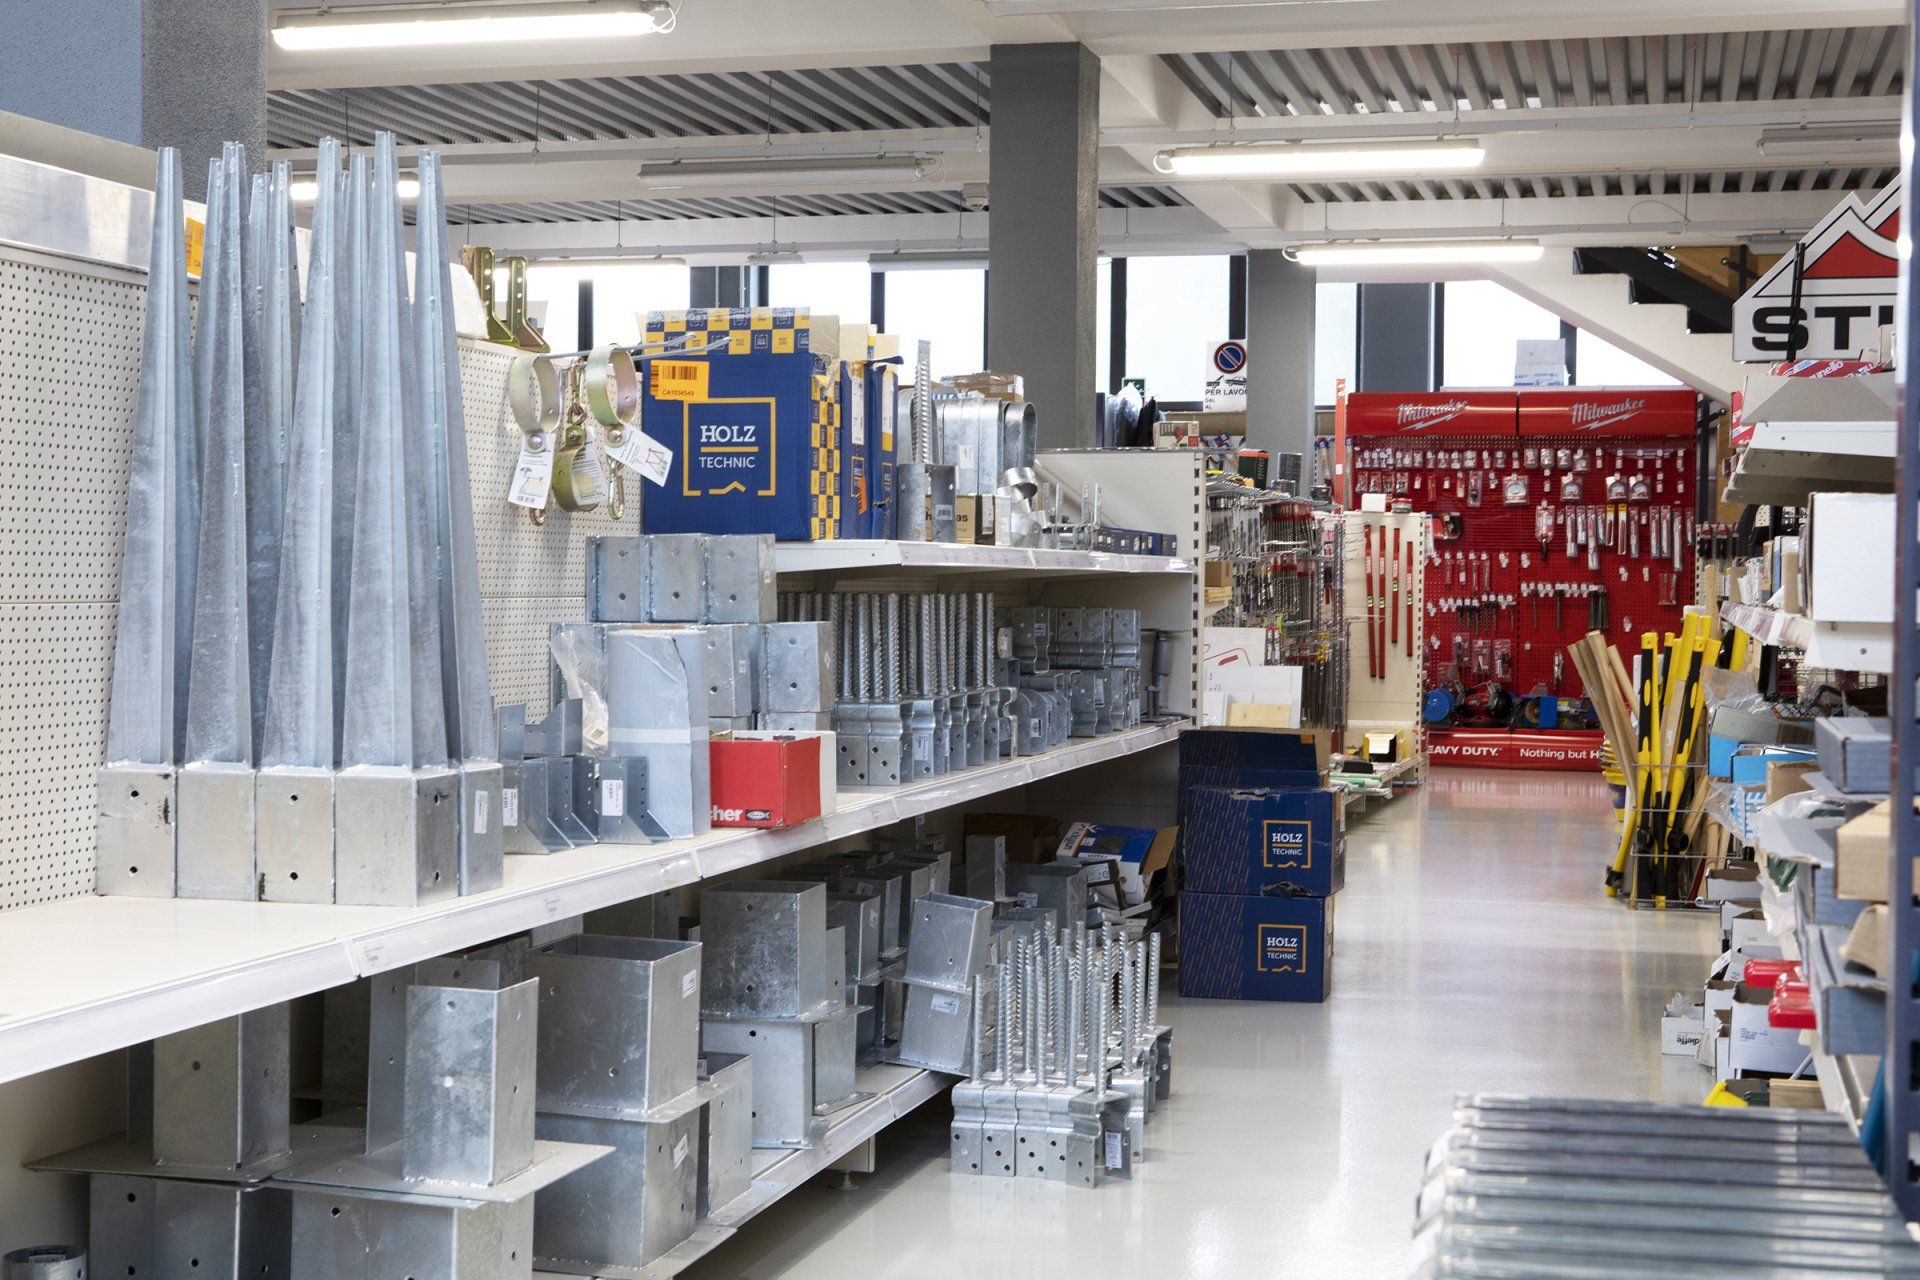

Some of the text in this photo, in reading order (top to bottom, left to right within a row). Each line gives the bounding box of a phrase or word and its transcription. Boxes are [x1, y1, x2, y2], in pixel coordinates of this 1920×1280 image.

[1396, 398, 1469, 425] Milwaukee
[1569, 398, 1646, 425] Milwaukee
[700, 425, 756, 442] HOLZ
[699, 456, 756, 469] TECHNIC
[1520, 748, 1565, 760] Nothing
[1568, 750, 1587, 759] but
[710, 805, 743, 822] her
[1272, 833, 1303, 843] HOLZ
[1272, 848, 1303, 856] TECHNIC
[1266, 937, 1298, 947] HOLZ
[1267, 952, 1298, 960] TECHNIC
